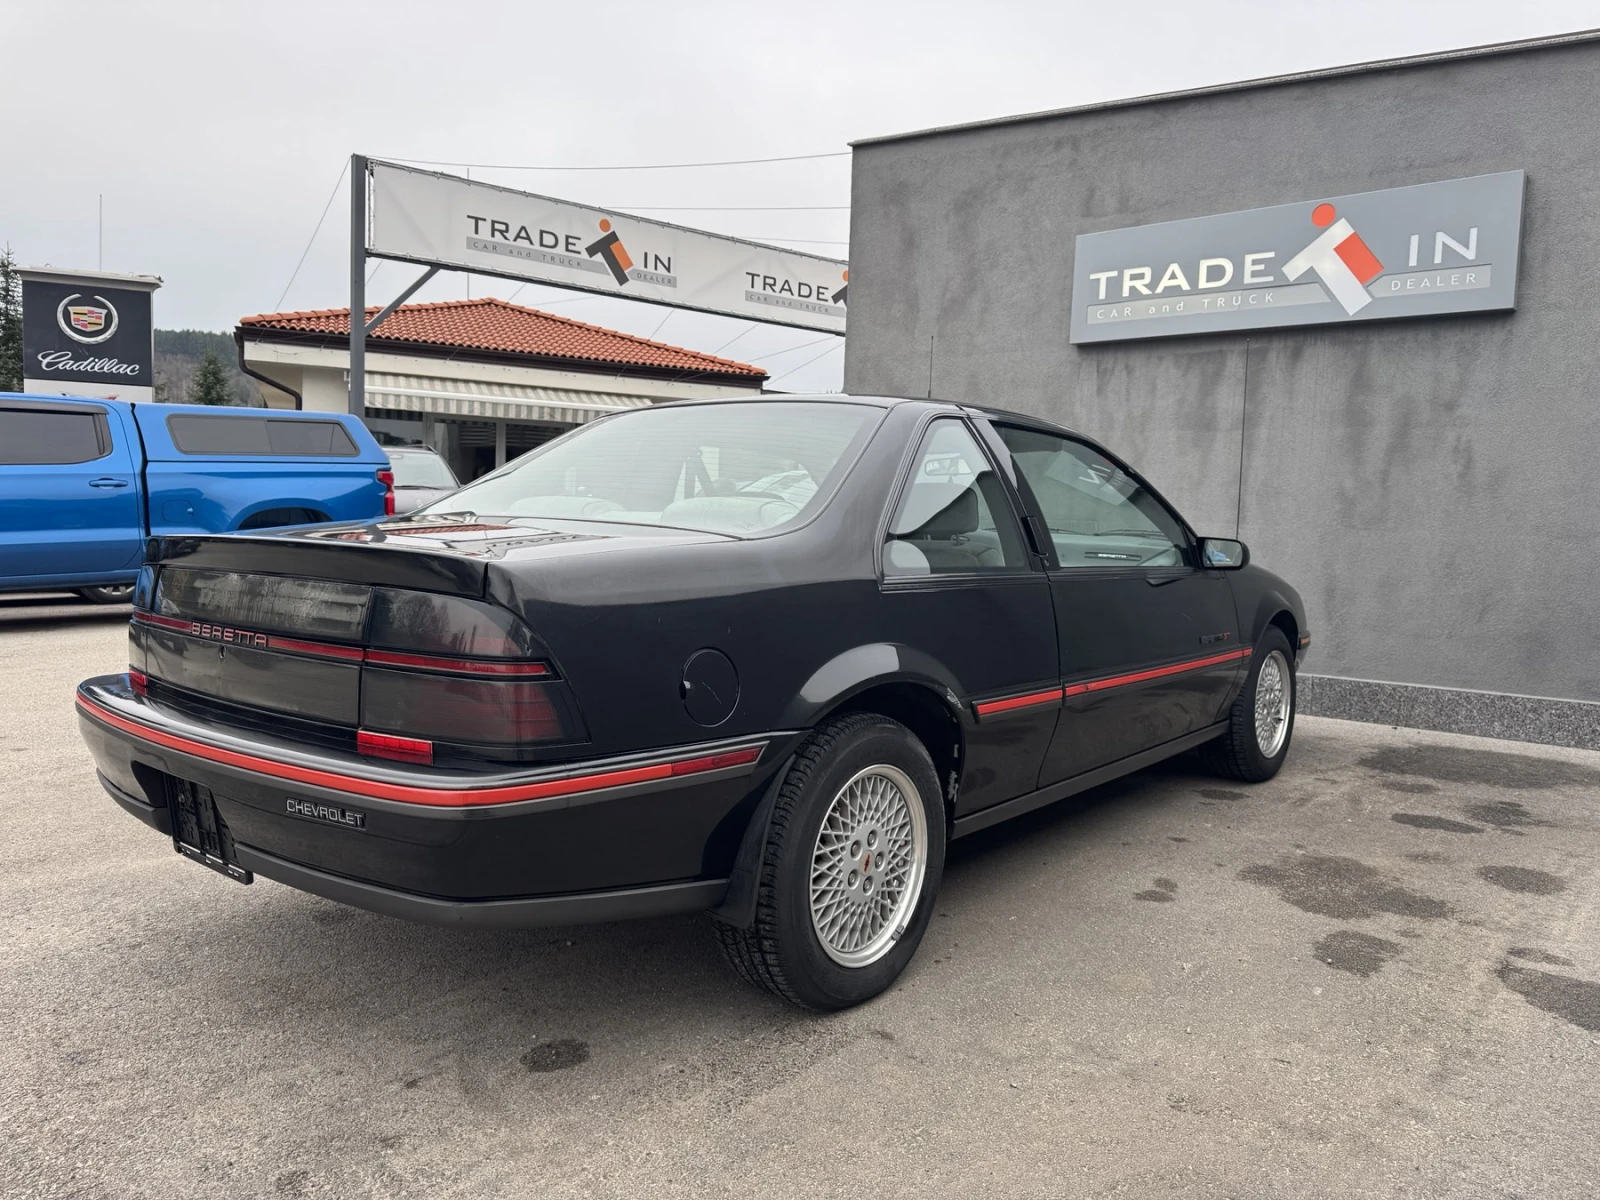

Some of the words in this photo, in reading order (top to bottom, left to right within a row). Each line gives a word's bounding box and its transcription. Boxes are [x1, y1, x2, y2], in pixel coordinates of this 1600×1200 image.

[466, 214, 582, 255] TRADE
[643, 251, 672, 274] IN
[472, 241, 498, 252] CAR
[508, 249, 532, 258] and
[541, 253, 582, 267] TRUCK
[636, 272, 673, 285] DEALER
[1089, 251, 1276, 300] TRADE
[1408, 227, 1478, 267] IN
[745, 271, 829, 302] TRADE
[1096, 307, 1132, 319] CAR
[1148, 301, 1184, 314] and
[1202, 292, 1274, 309] TRUCK
[1391, 272, 1476, 291] DEALER
[749, 294, 768, 303] CAR
[775, 299, 792, 307] and
[799, 303, 829, 313] TRUCK
[37, 350, 140, 376] Cadillac
[191, 622, 267, 648] BERETTA
[286, 799, 363, 826] CHEVROLET
